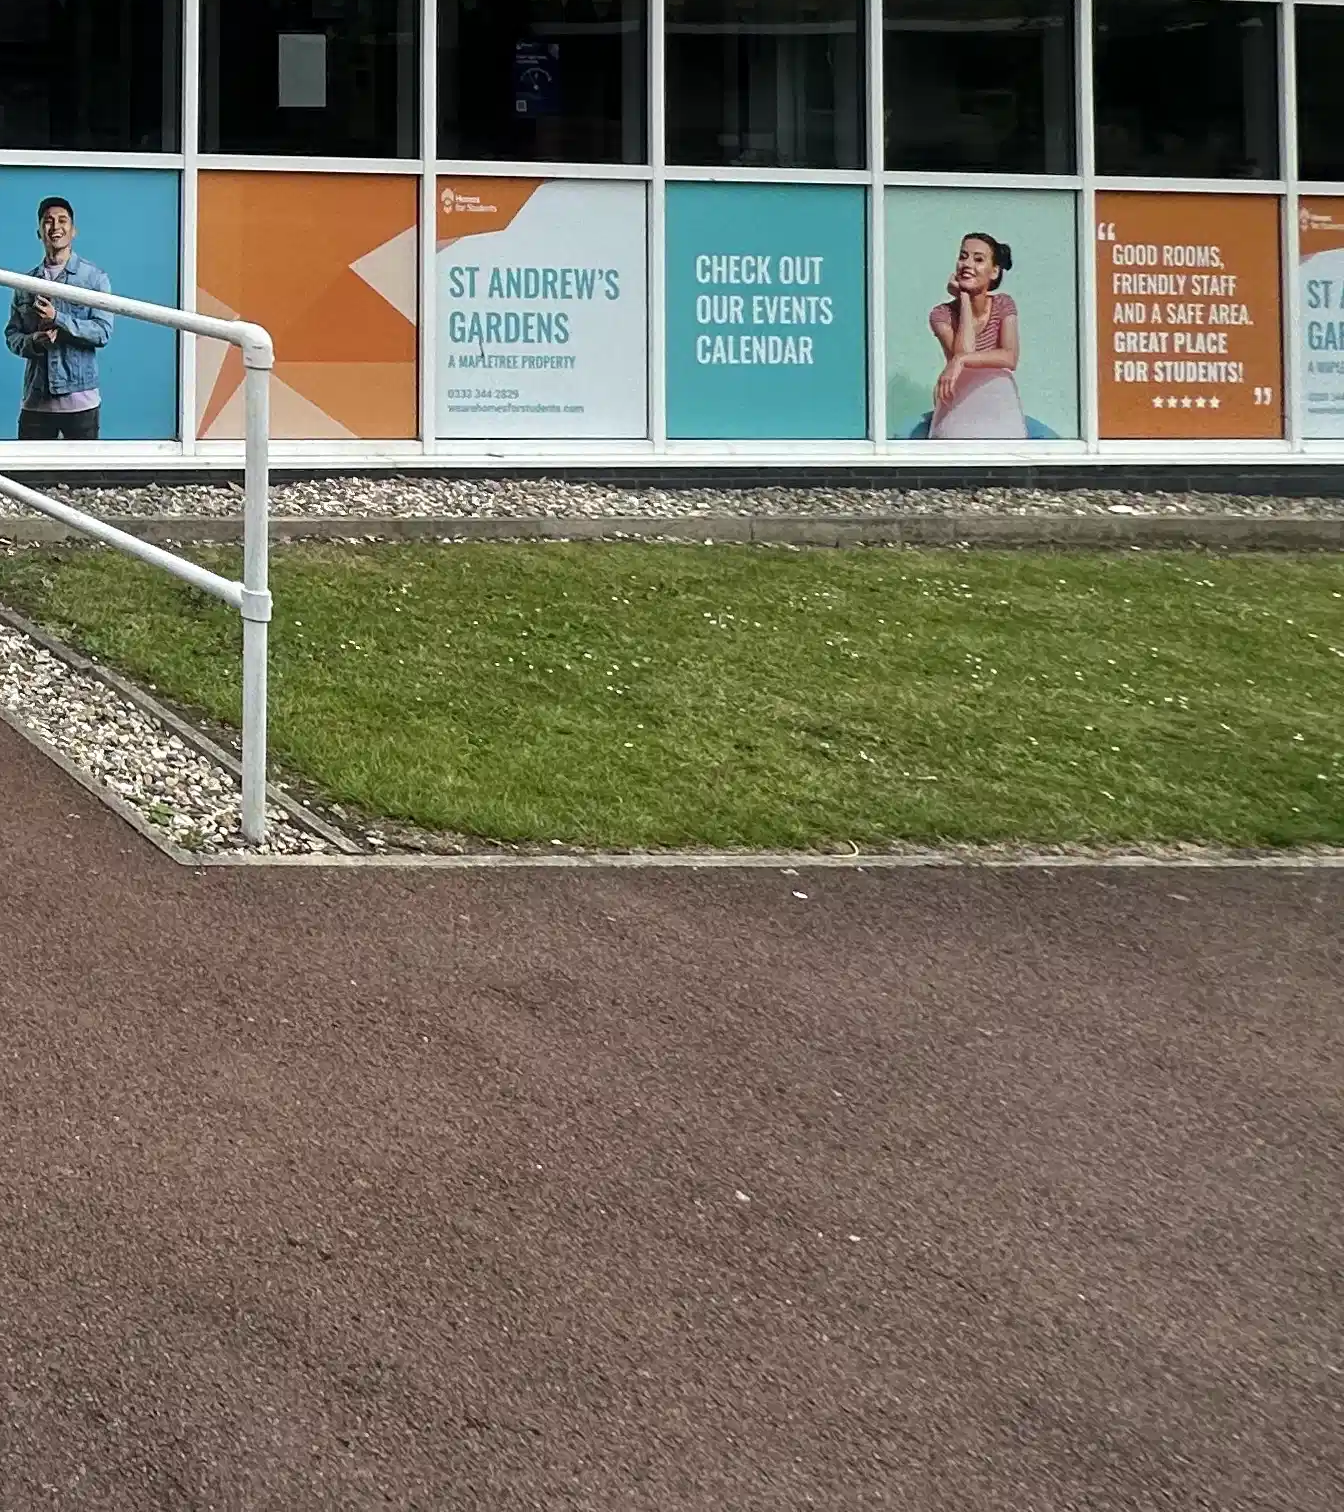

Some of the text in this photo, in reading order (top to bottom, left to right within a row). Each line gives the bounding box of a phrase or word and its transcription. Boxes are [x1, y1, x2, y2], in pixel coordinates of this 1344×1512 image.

[696, 255, 824, 285] CHECK OUT
[1112, 244, 1225, 269] GOOD ROOMS,
[449, 266, 620, 301] ST ANDREW'S
[1112, 273, 1237, 296] FRIENDLY STAFF
[1307, 280, 1333, 309] ST
[696, 295, 833, 325] OUR EVENTS
[1113, 303, 1254, 325] AND A SAFE AREA.
[449, 311, 570, 344] GARDENS
[696, 335, 814, 364] CALENDAR
[1113, 331, 1229, 354] GREAT PLACE
[448, 355, 456, 369] A
[521, 355, 576, 370] PROPERTY
[1114, 361, 1244, 383] FOR STUDENTS!
